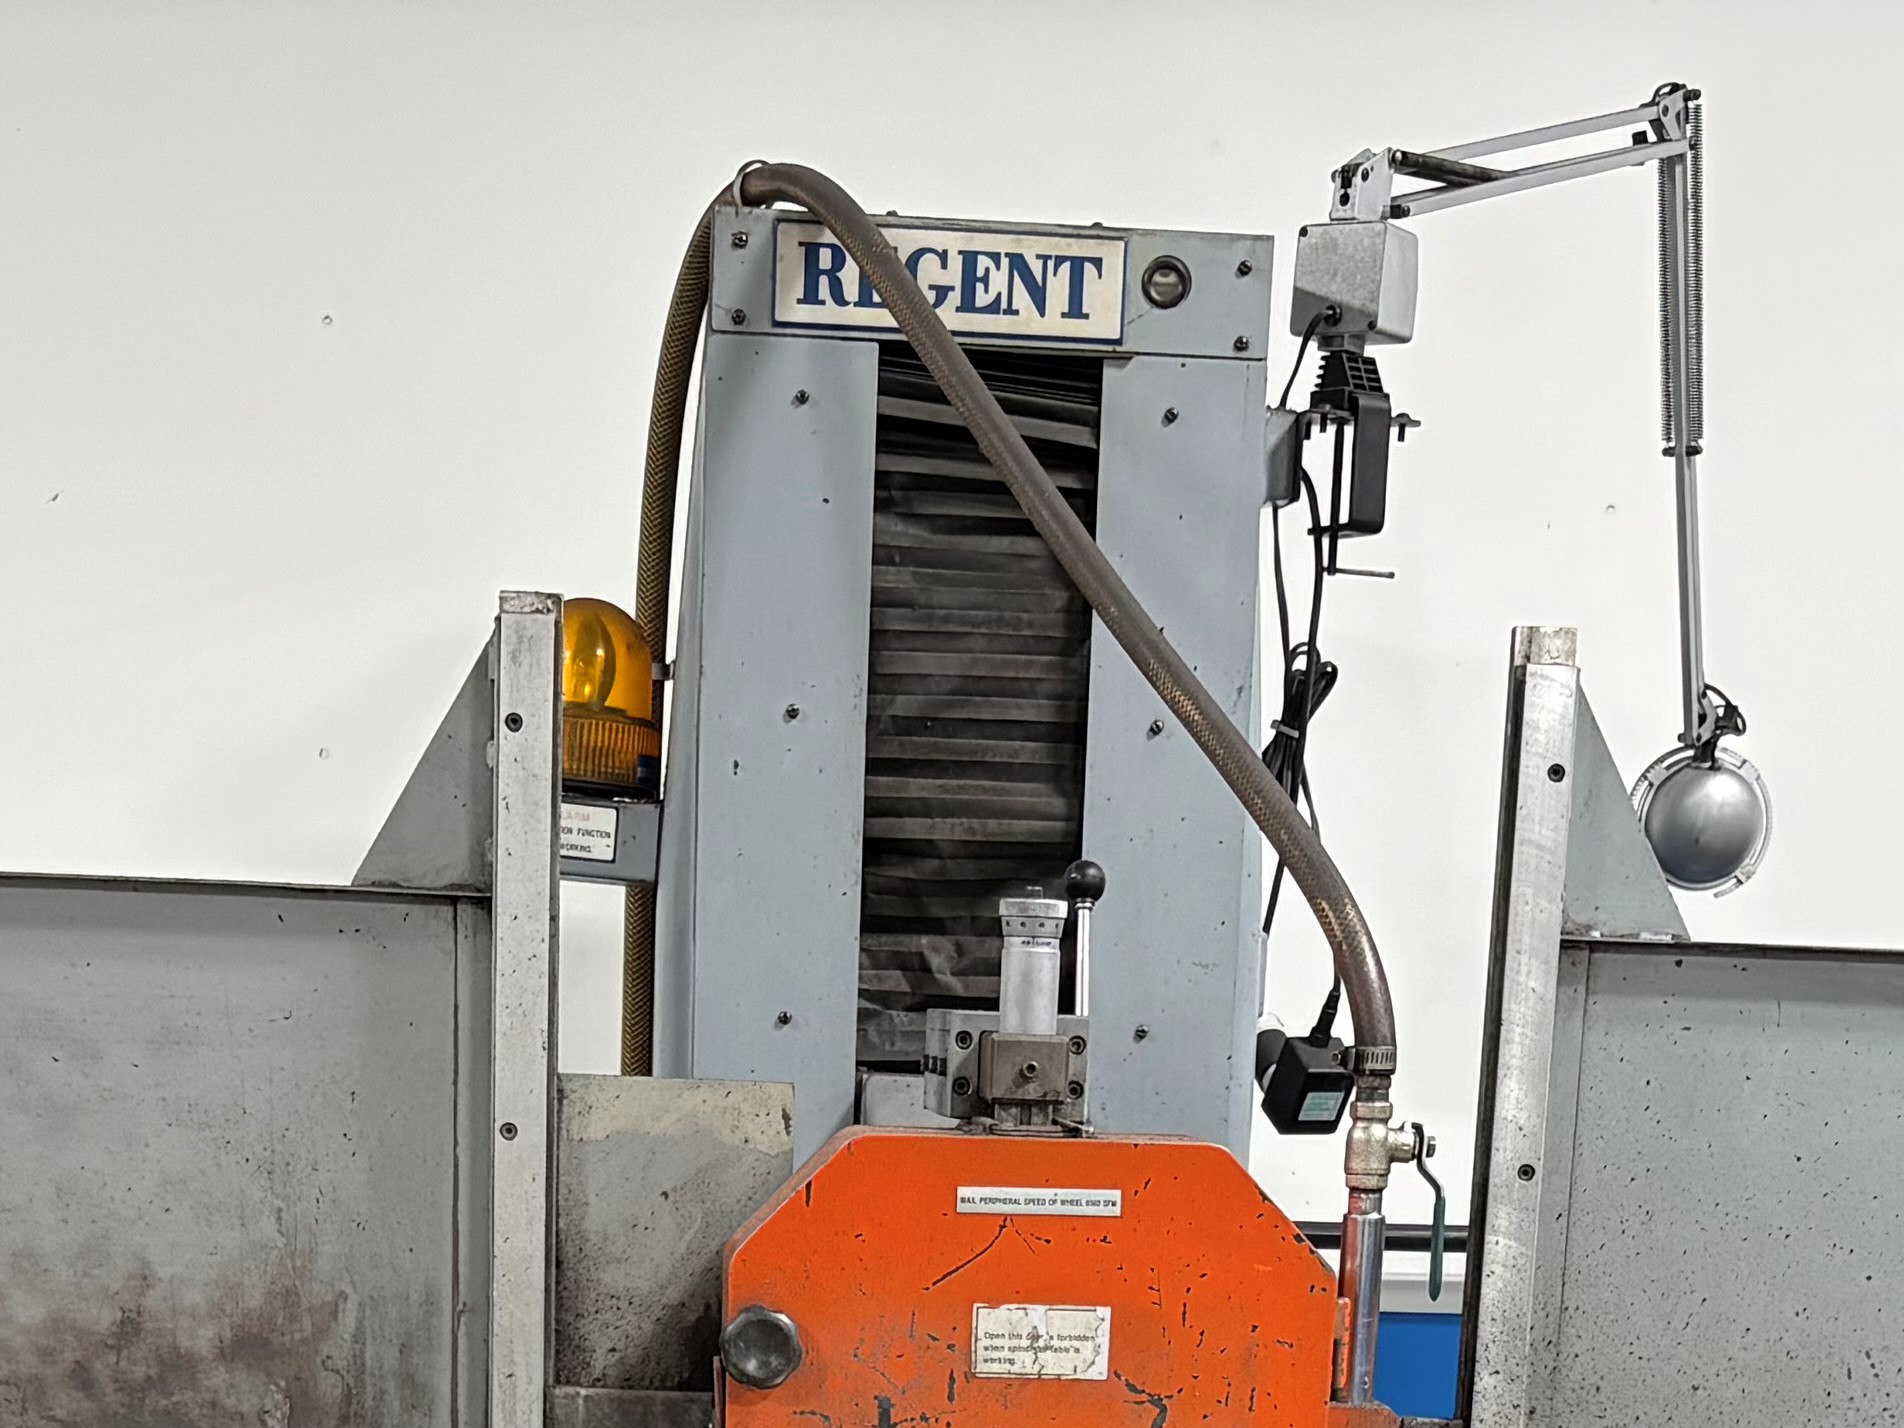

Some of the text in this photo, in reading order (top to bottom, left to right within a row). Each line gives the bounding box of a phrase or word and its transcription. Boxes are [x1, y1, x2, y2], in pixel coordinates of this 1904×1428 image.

[979, 1197, 1022, 1206] PERIPHERAL
[1024, 1198, 1046, 1206] SPEED
[1048, 1198, 1058, 1206] OF
[984, 1331, 1005, 1341] Open
[1008, 1332, 1023, 1340] this
[1057, 1333, 1096, 1342] forbidden
